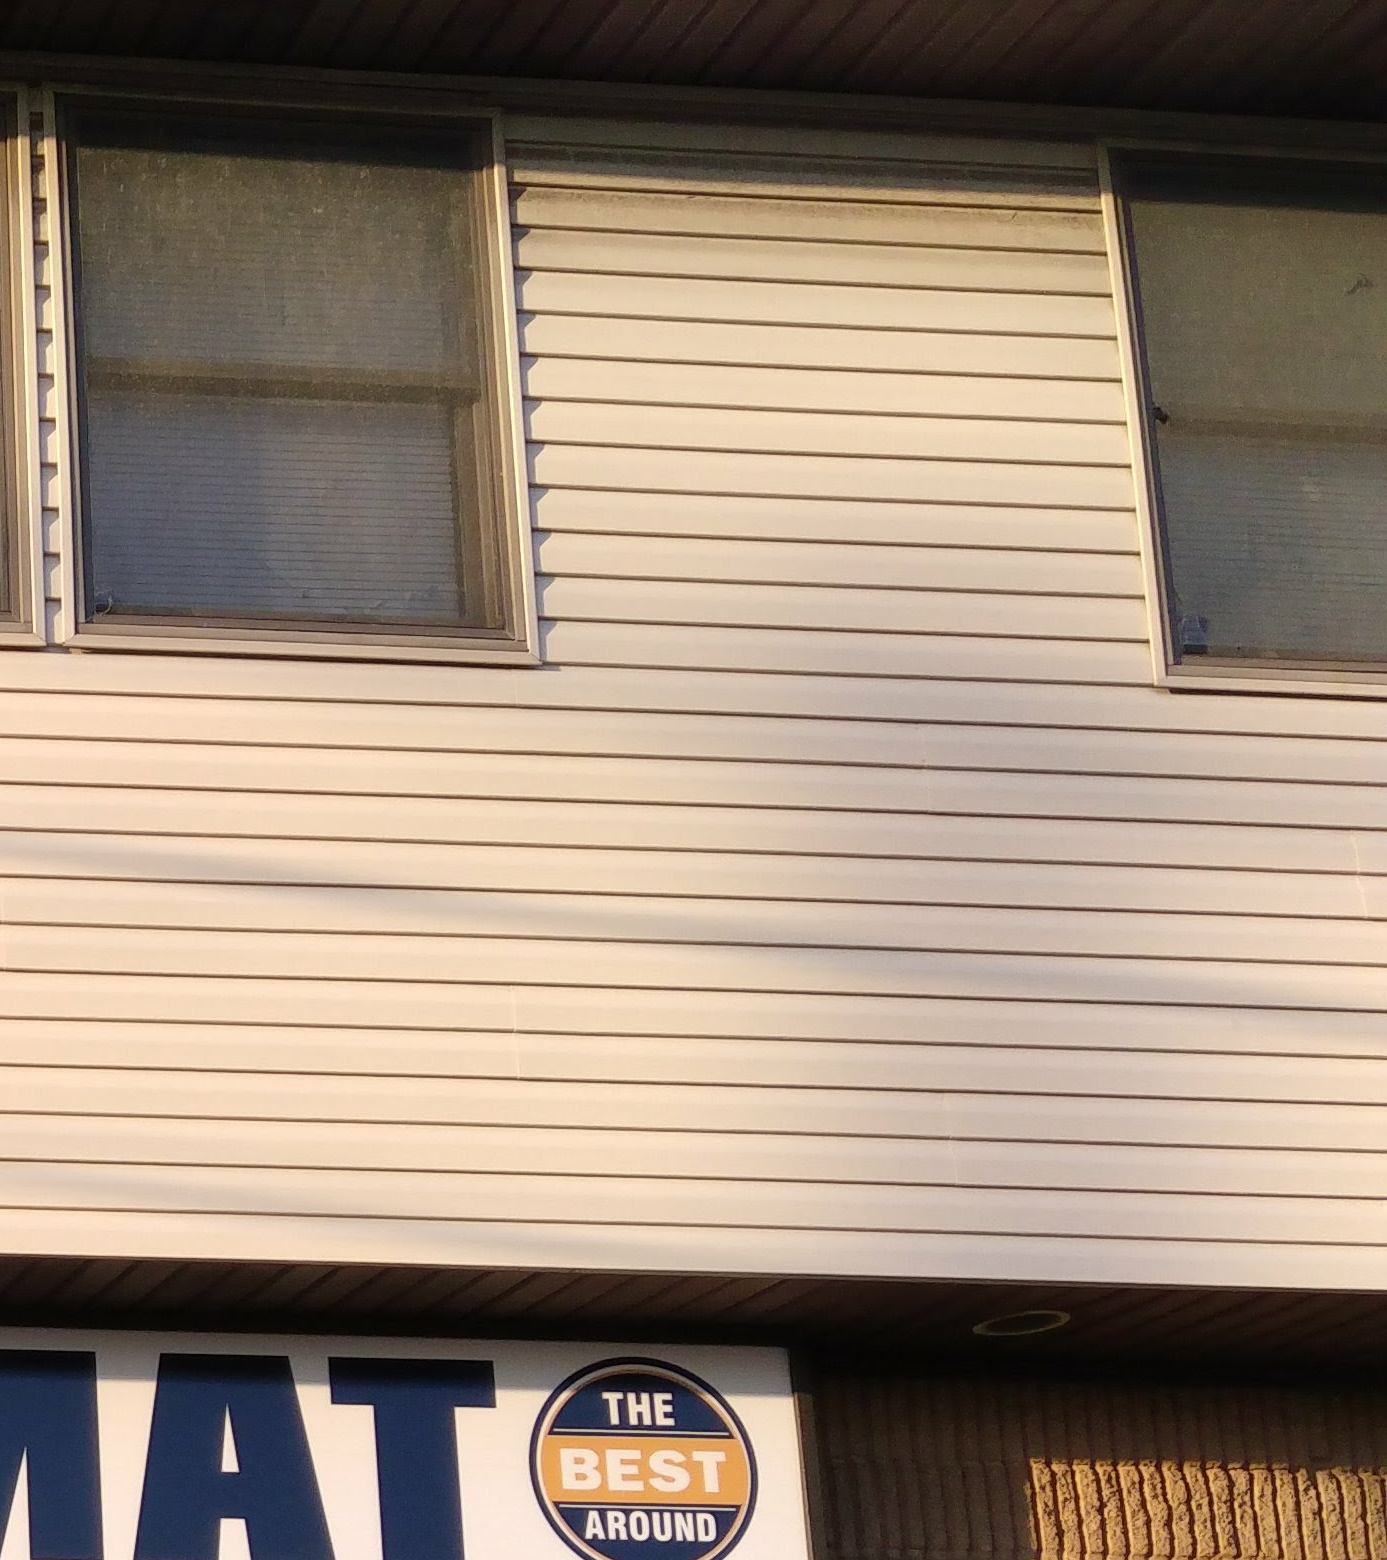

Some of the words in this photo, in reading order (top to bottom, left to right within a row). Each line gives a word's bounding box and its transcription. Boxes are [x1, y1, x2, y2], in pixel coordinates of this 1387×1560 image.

[601, 1390, 676, 1427] THE
[558, 1447, 727, 1494] BEST
[583, 1509, 718, 1543] AROUND
